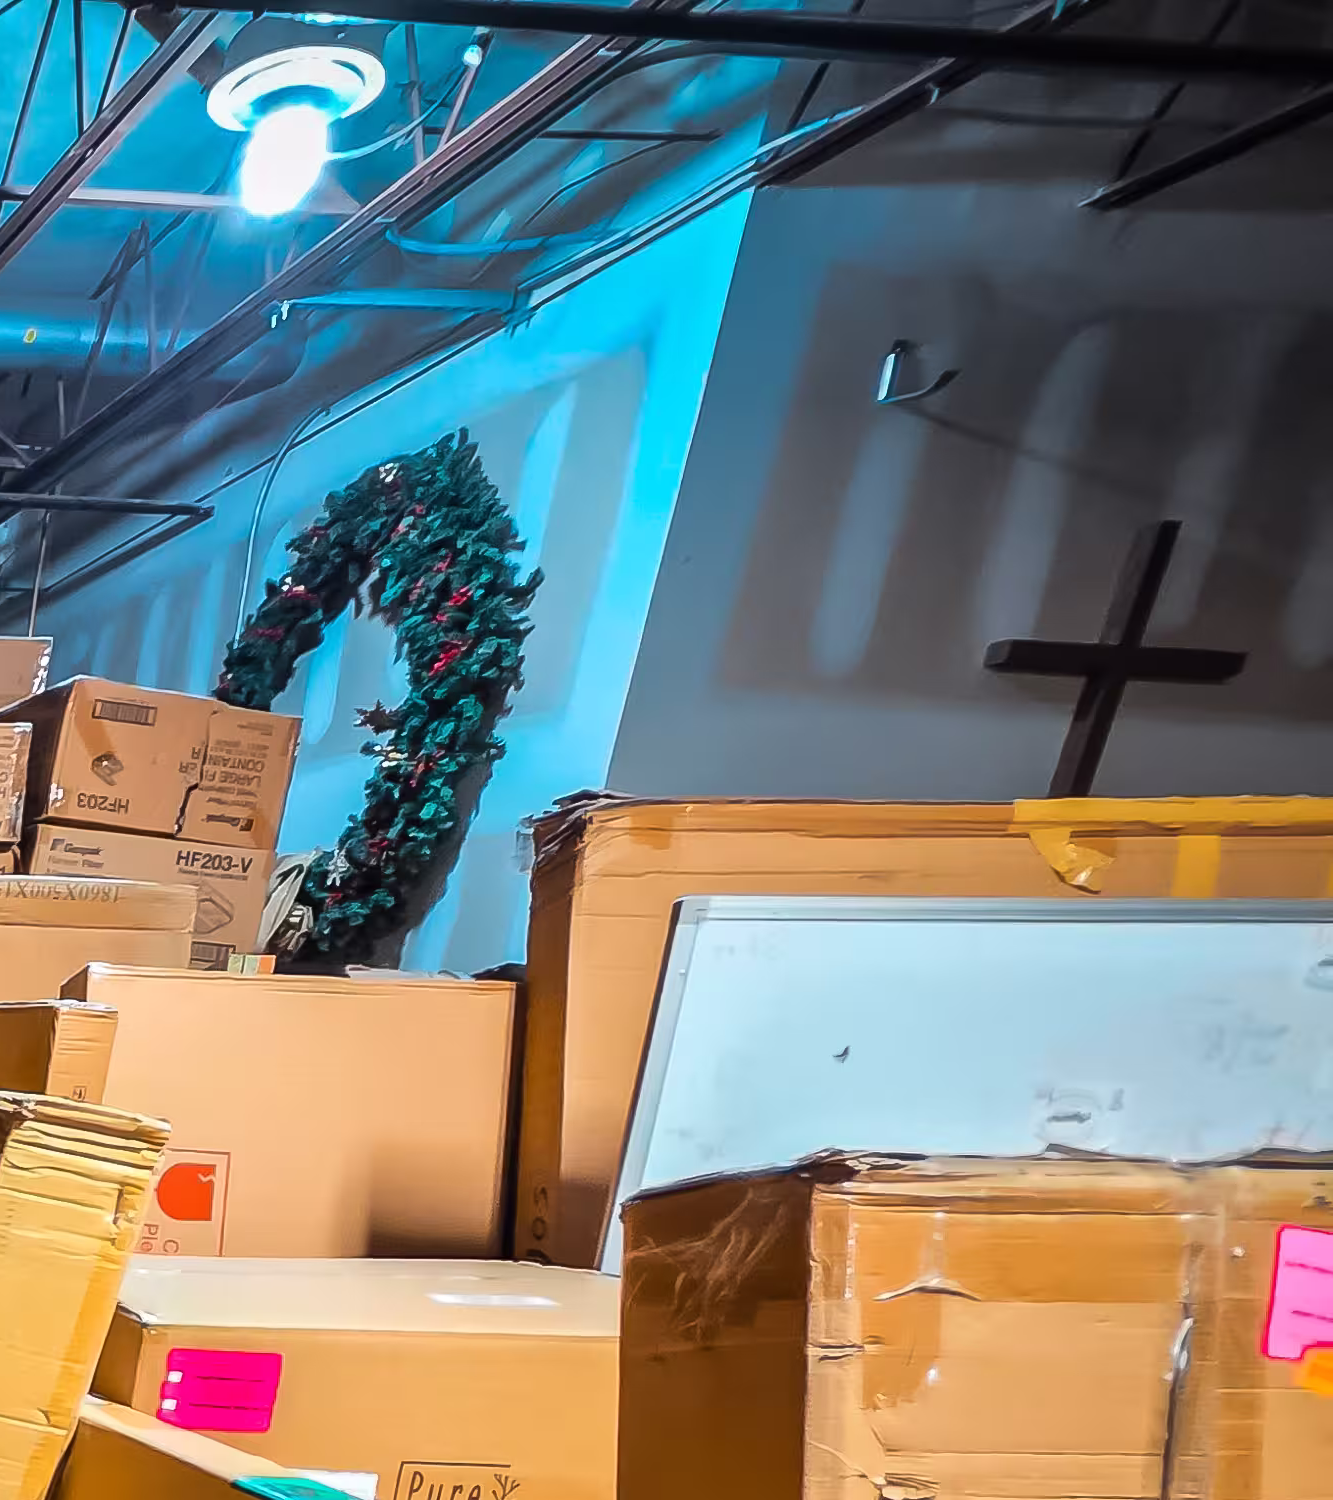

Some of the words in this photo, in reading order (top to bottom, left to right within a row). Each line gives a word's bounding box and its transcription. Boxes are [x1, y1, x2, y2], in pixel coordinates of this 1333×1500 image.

[190, 746, 266, 773] CONTAINR
[76, 792, 130, 815] HF203
[175, 849, 253, 875] HF203-V
